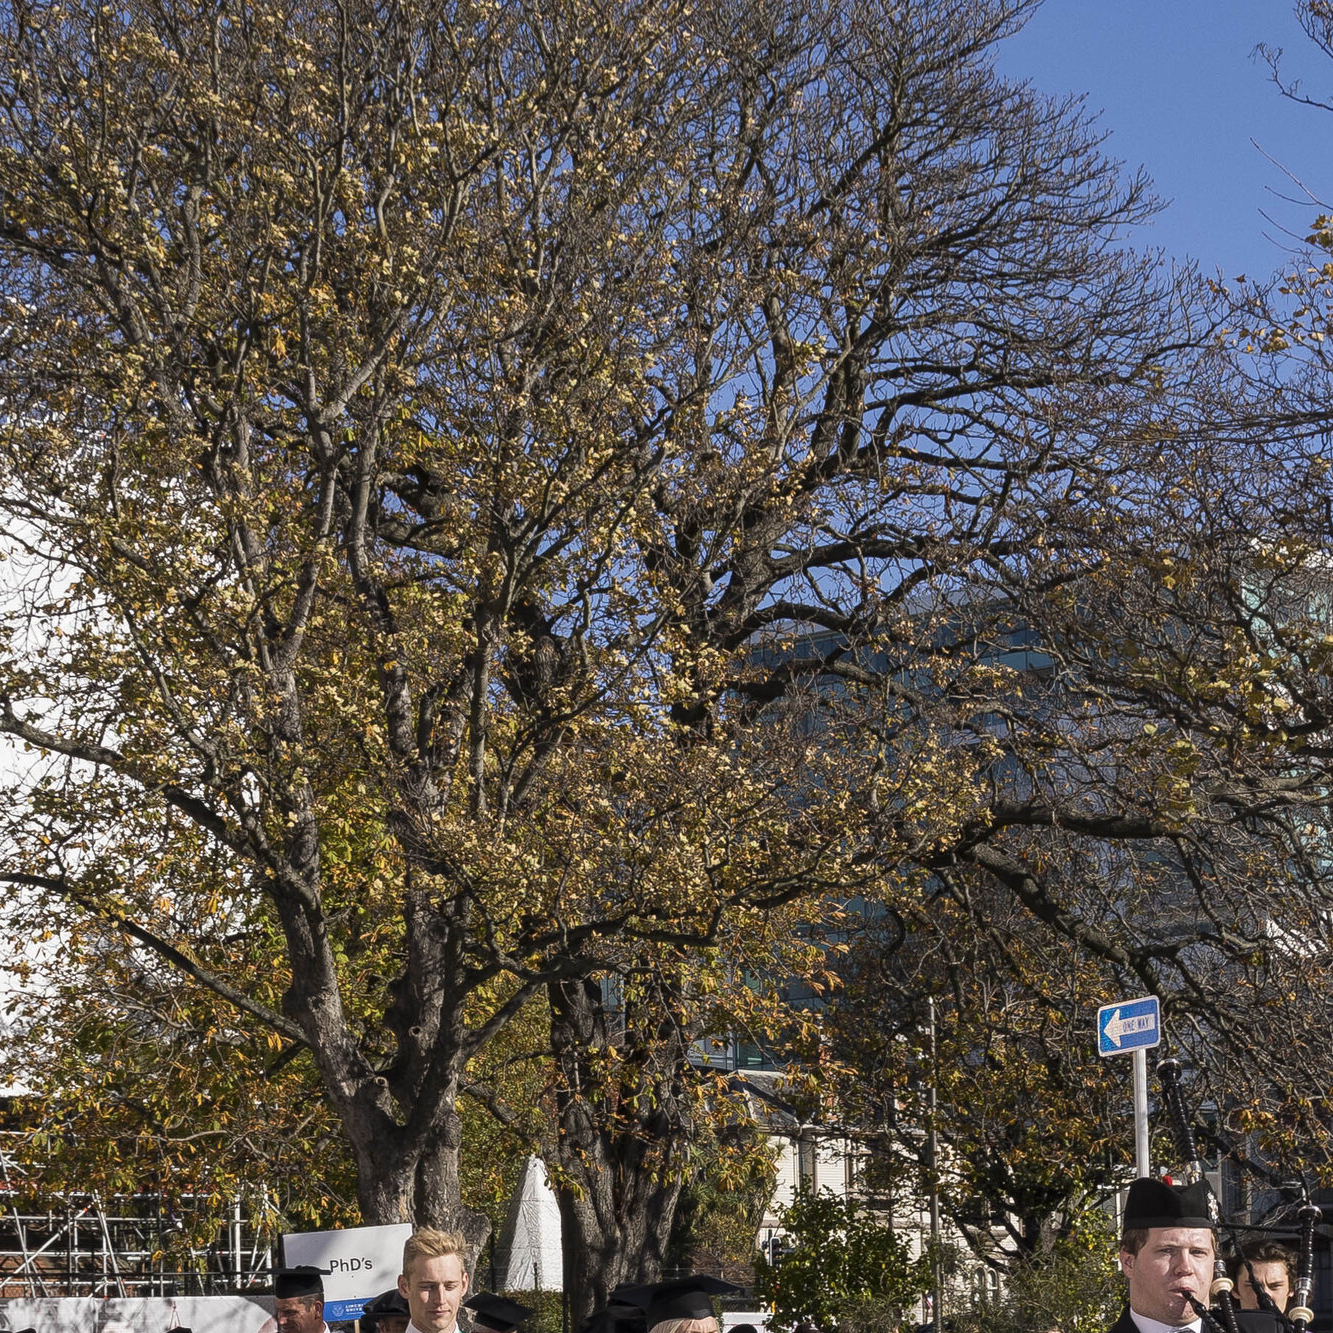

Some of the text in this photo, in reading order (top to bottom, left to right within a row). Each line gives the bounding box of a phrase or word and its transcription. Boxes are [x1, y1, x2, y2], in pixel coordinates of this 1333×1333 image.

[1123, 1016, 1149, 1033] ONE WAY
[329, 1257, 373, 1272] PhD's
